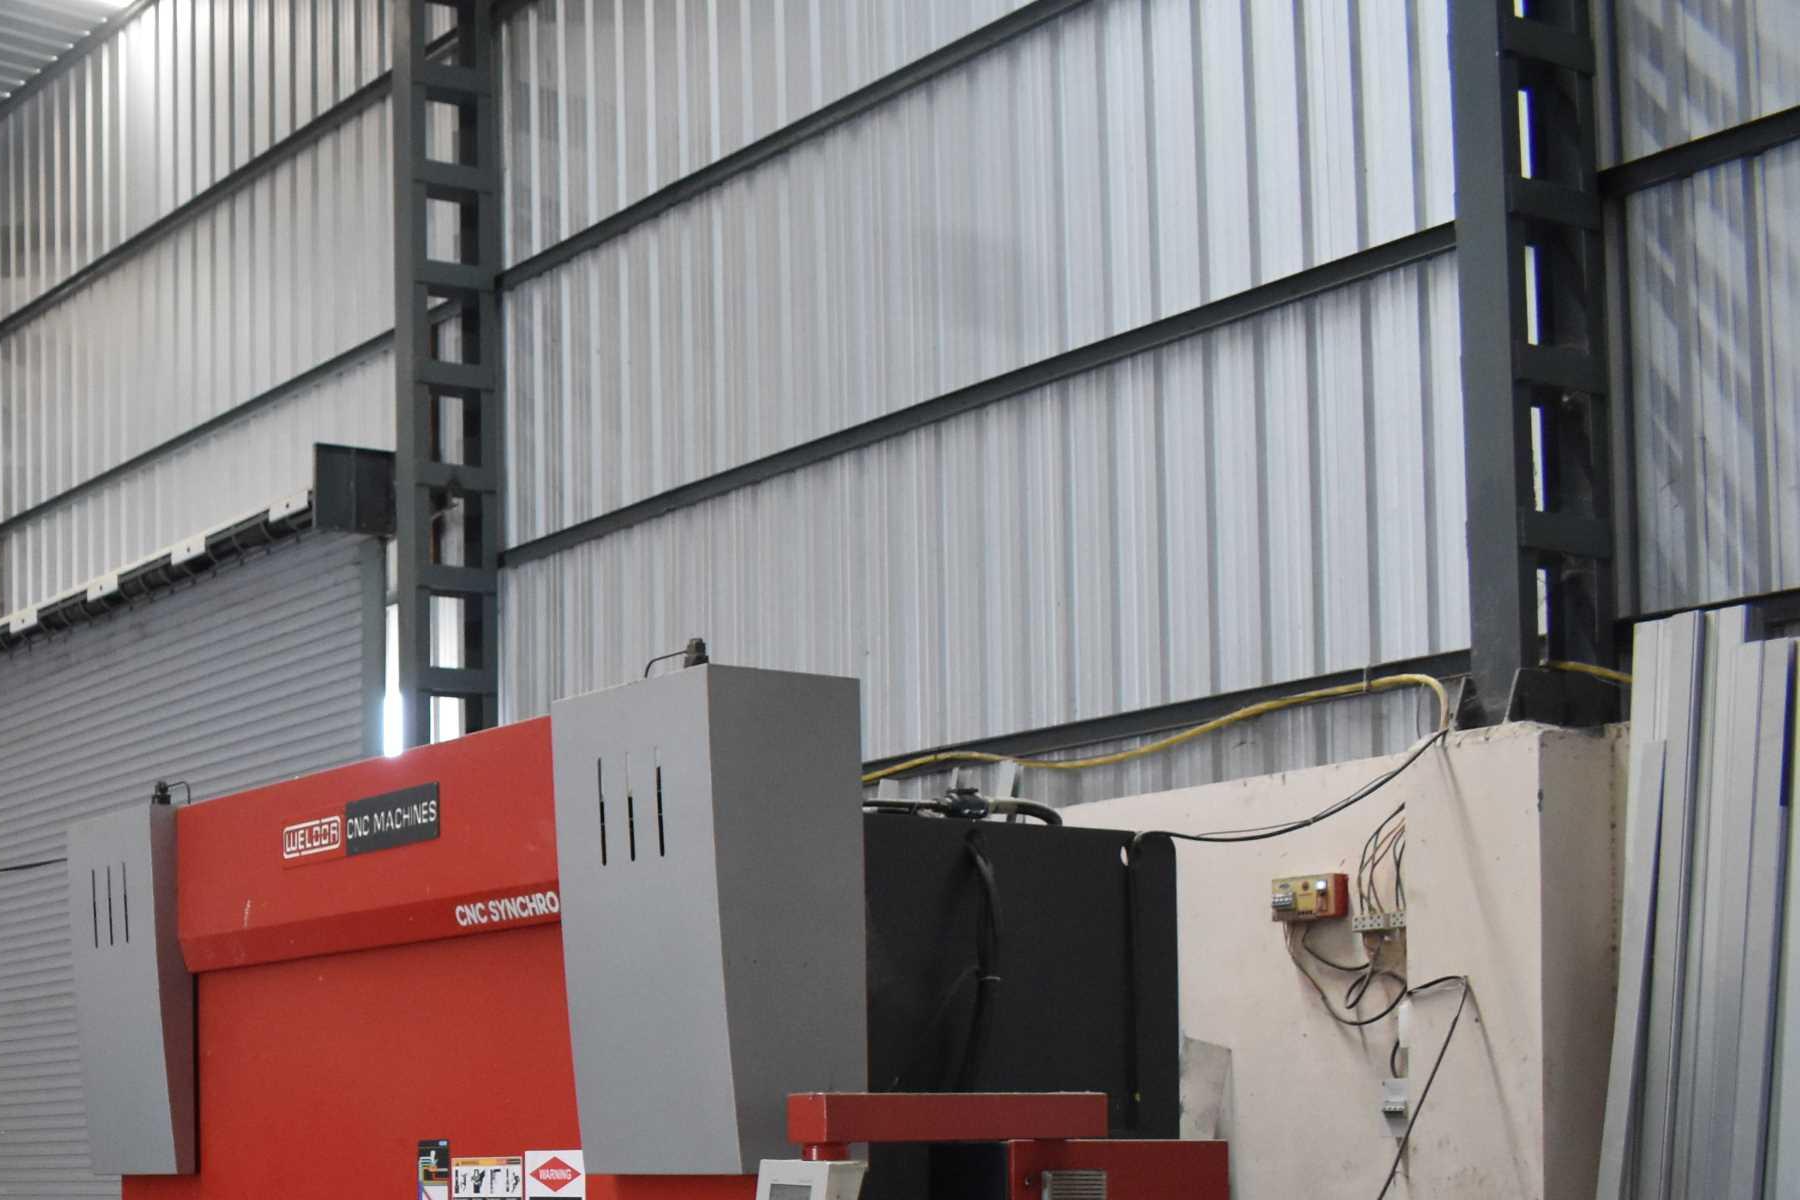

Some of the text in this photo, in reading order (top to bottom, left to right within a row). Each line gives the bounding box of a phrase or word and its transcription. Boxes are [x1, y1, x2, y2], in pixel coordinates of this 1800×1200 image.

[285, 799, 438, 853] WELDOR CNC MACHINES
[455, 890, 560, 927] CNC SYNCHRO
[538, 1168, 572, 1181] WARNING
